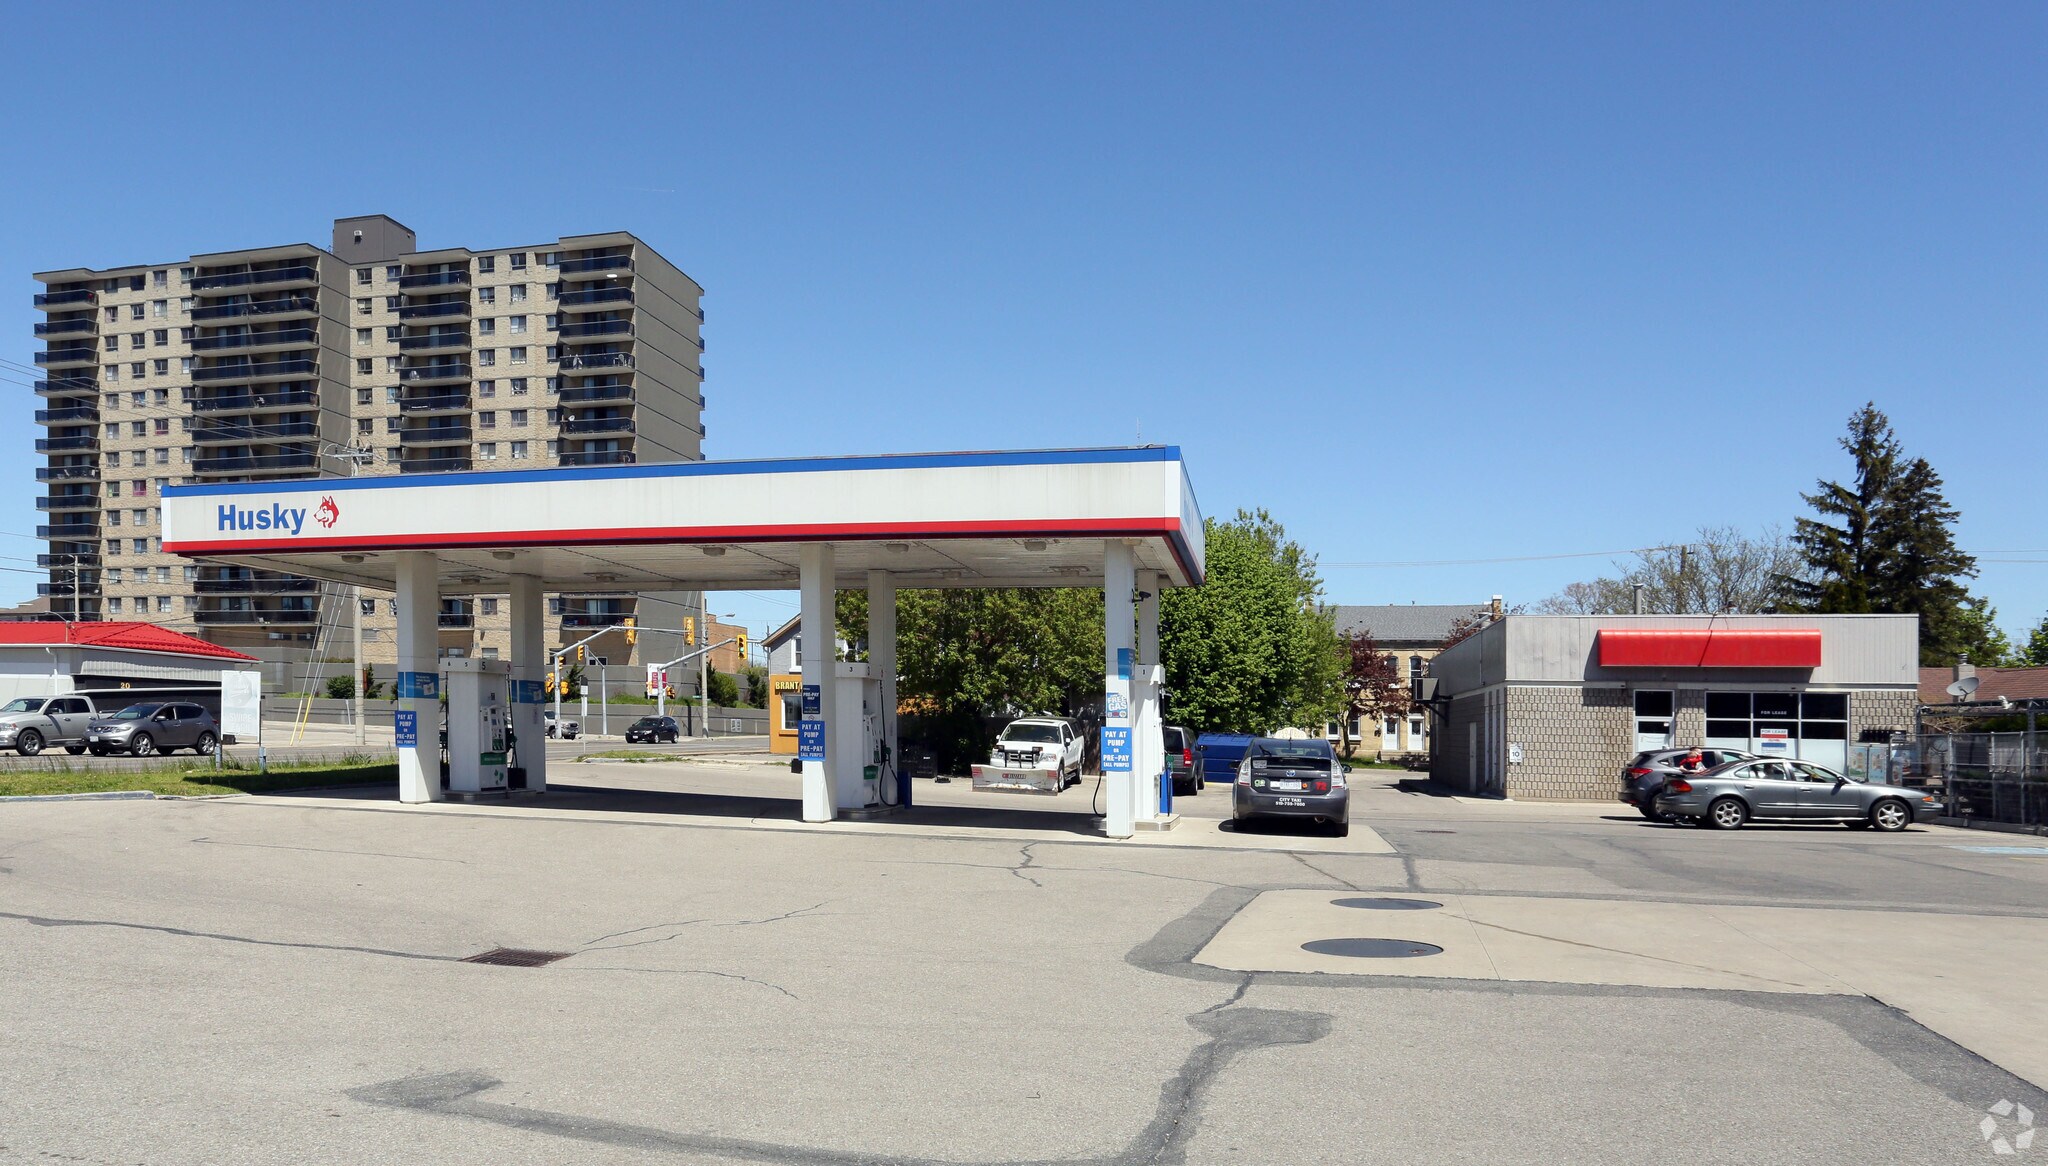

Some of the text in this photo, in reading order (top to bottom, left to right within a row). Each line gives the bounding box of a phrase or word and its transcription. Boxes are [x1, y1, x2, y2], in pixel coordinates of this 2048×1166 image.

[218, 503, 306, 535] Husky
[482, 662, 486, 670] 5
[1108, 701, 1127, 711] GAS
[1316, 782, 1327, 790] 72
